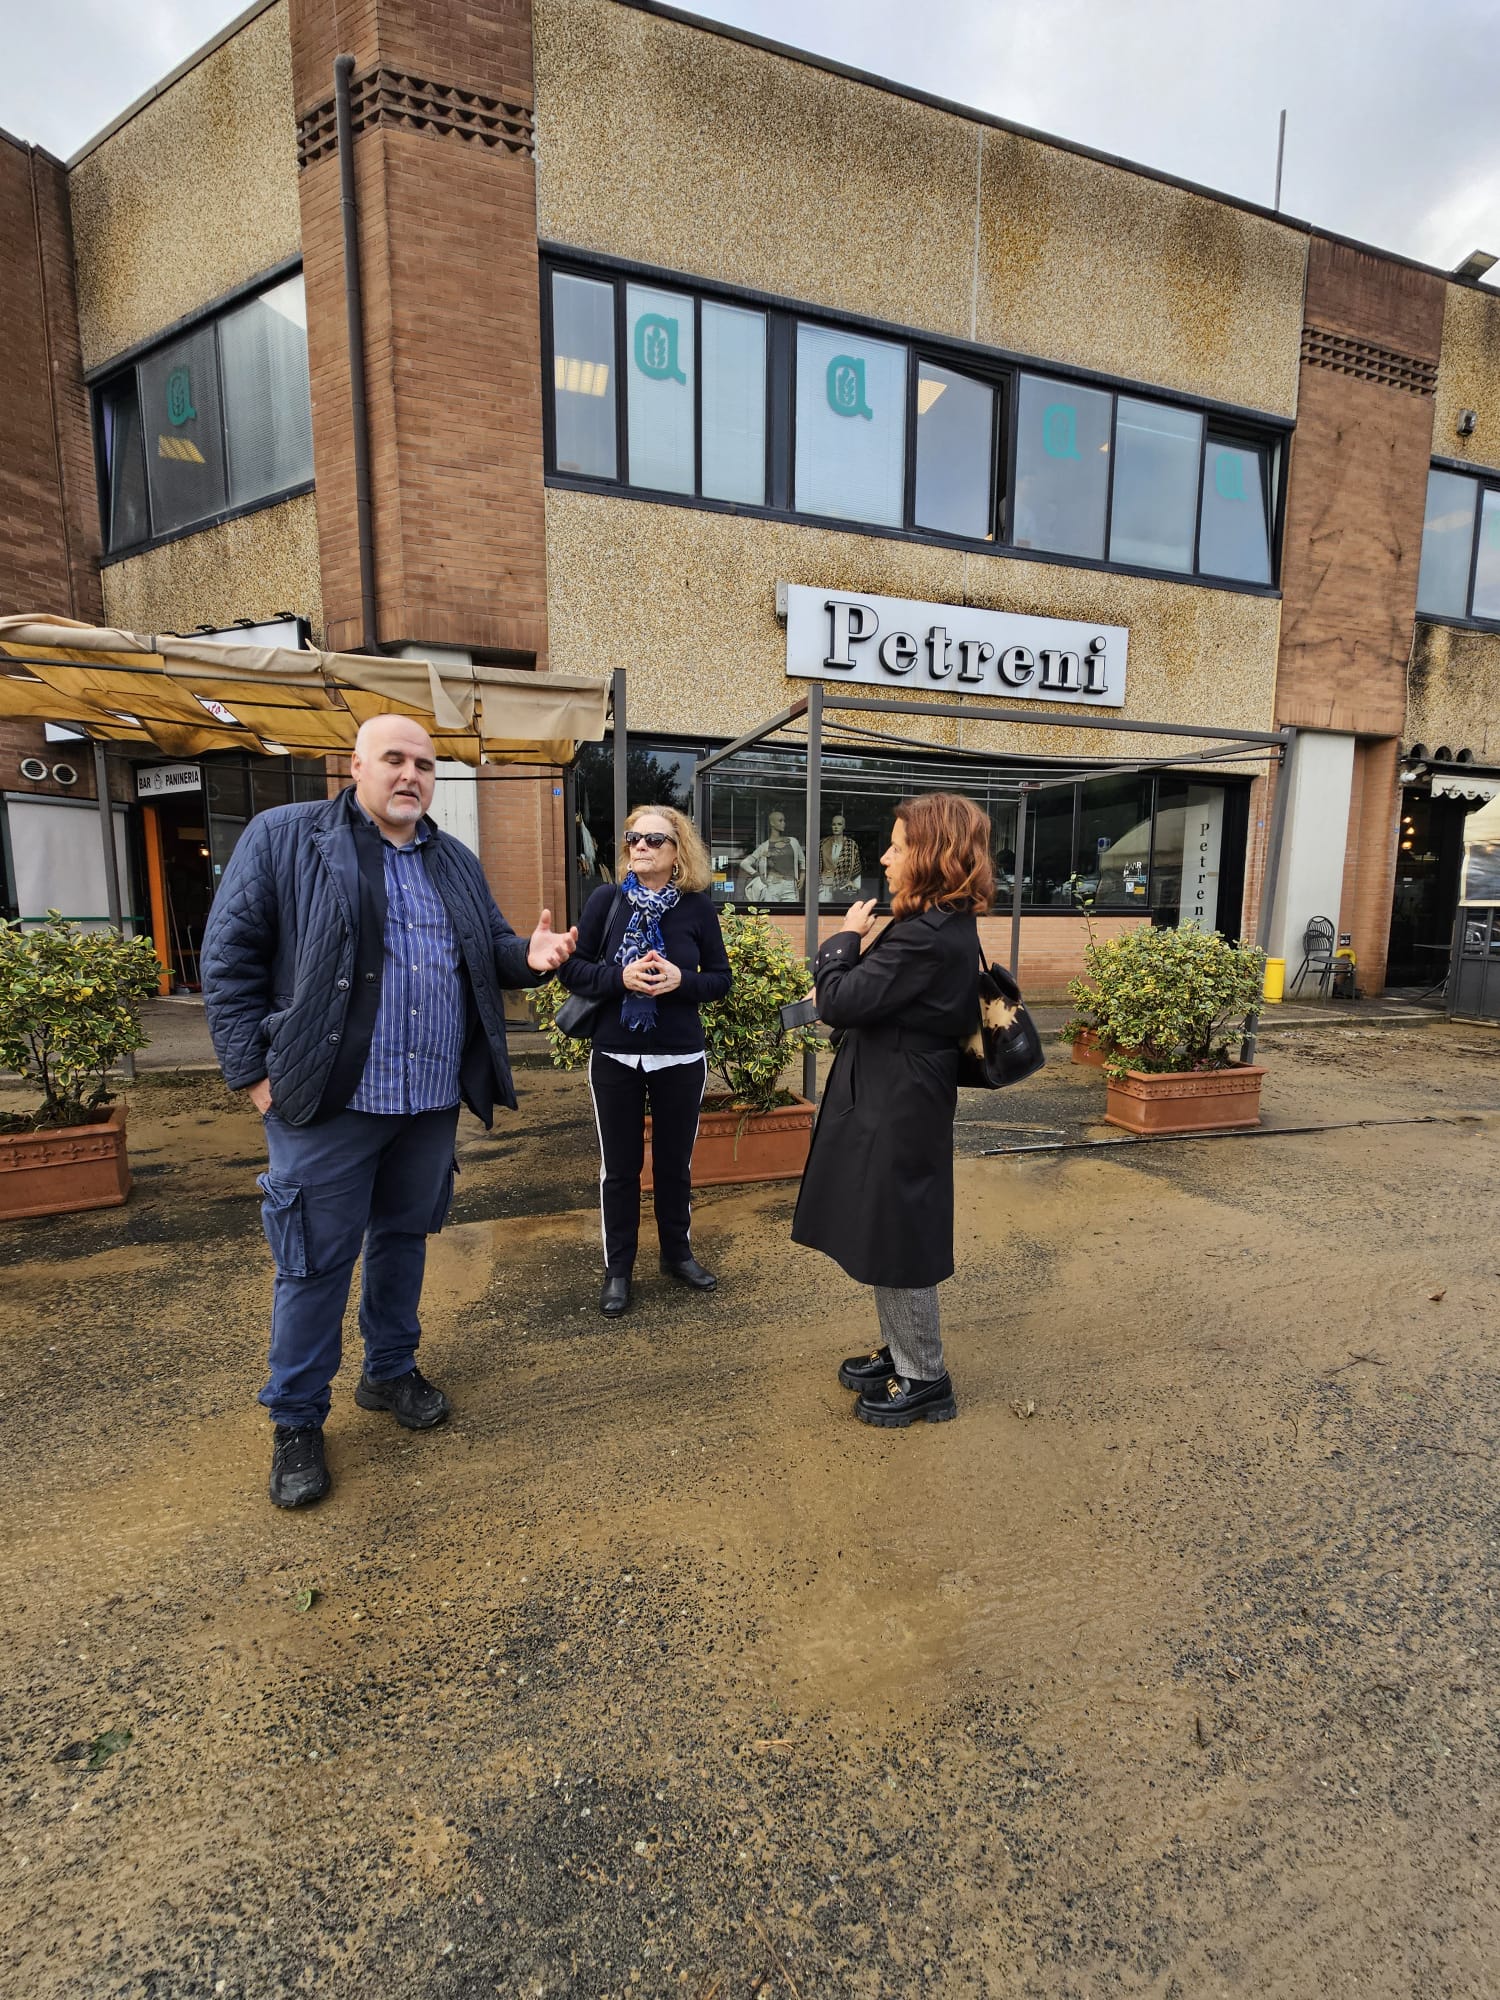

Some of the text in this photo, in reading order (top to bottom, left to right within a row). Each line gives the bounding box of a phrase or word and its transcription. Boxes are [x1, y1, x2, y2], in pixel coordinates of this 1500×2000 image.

[823, 600, 1109, 694] Petreni
[139, 771, 199, 789] BAR PANINERIA
